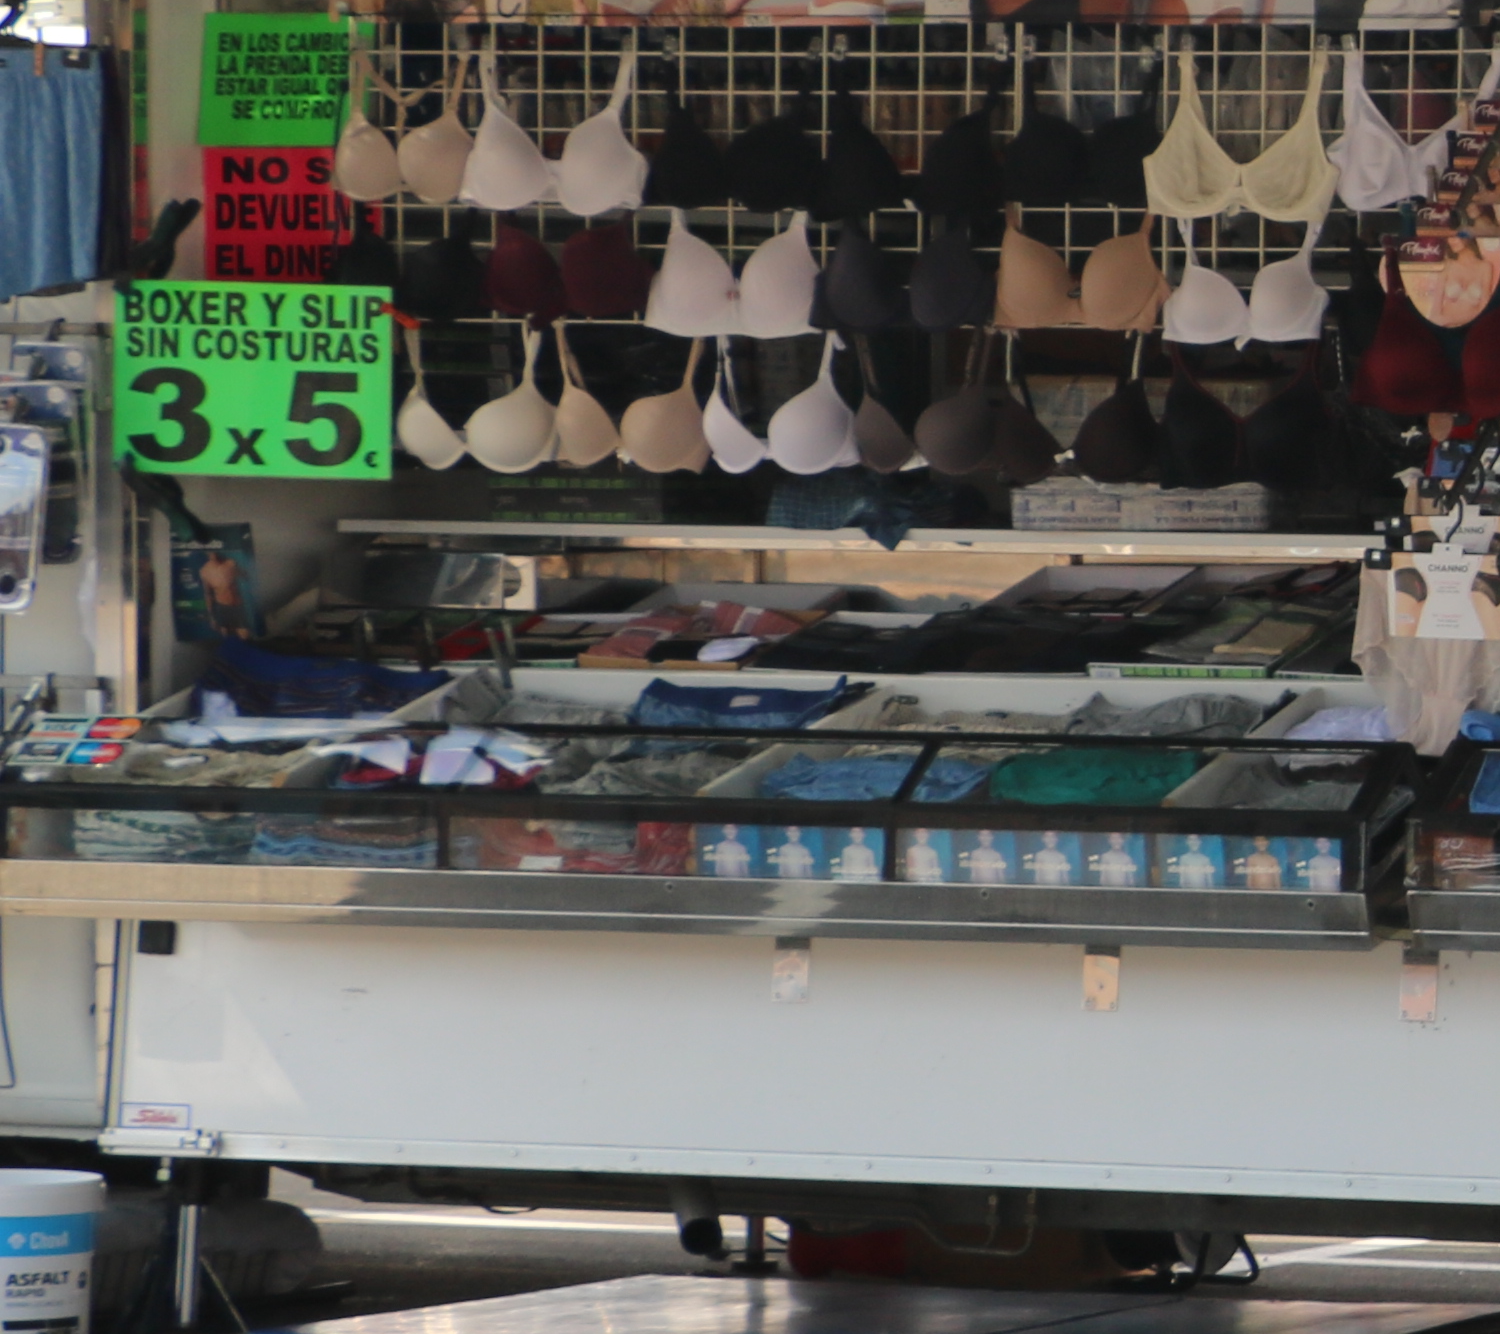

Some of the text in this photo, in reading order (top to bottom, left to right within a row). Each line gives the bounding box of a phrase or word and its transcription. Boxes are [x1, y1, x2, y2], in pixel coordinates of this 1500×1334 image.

[218, 33, 349, 53] EN LOS CAMBIO
[216, 55, 349, 75] LA PRENDA DEB
[215, 78, 268, 96] ESTAR
[273, 78, 320, 96] IGUAL
[232, 100, 254, 120] SE
[222, 156, 331, 185] NO S
[215, 244, 254, 277] EL
[124, 289, 385, 330] BOXER Y SLIP
[126, 327, 380, 364] SIN COSTURAS
[128, 367, 212, 463] 3
[6, 1270, 71, 1287] ASFALT
